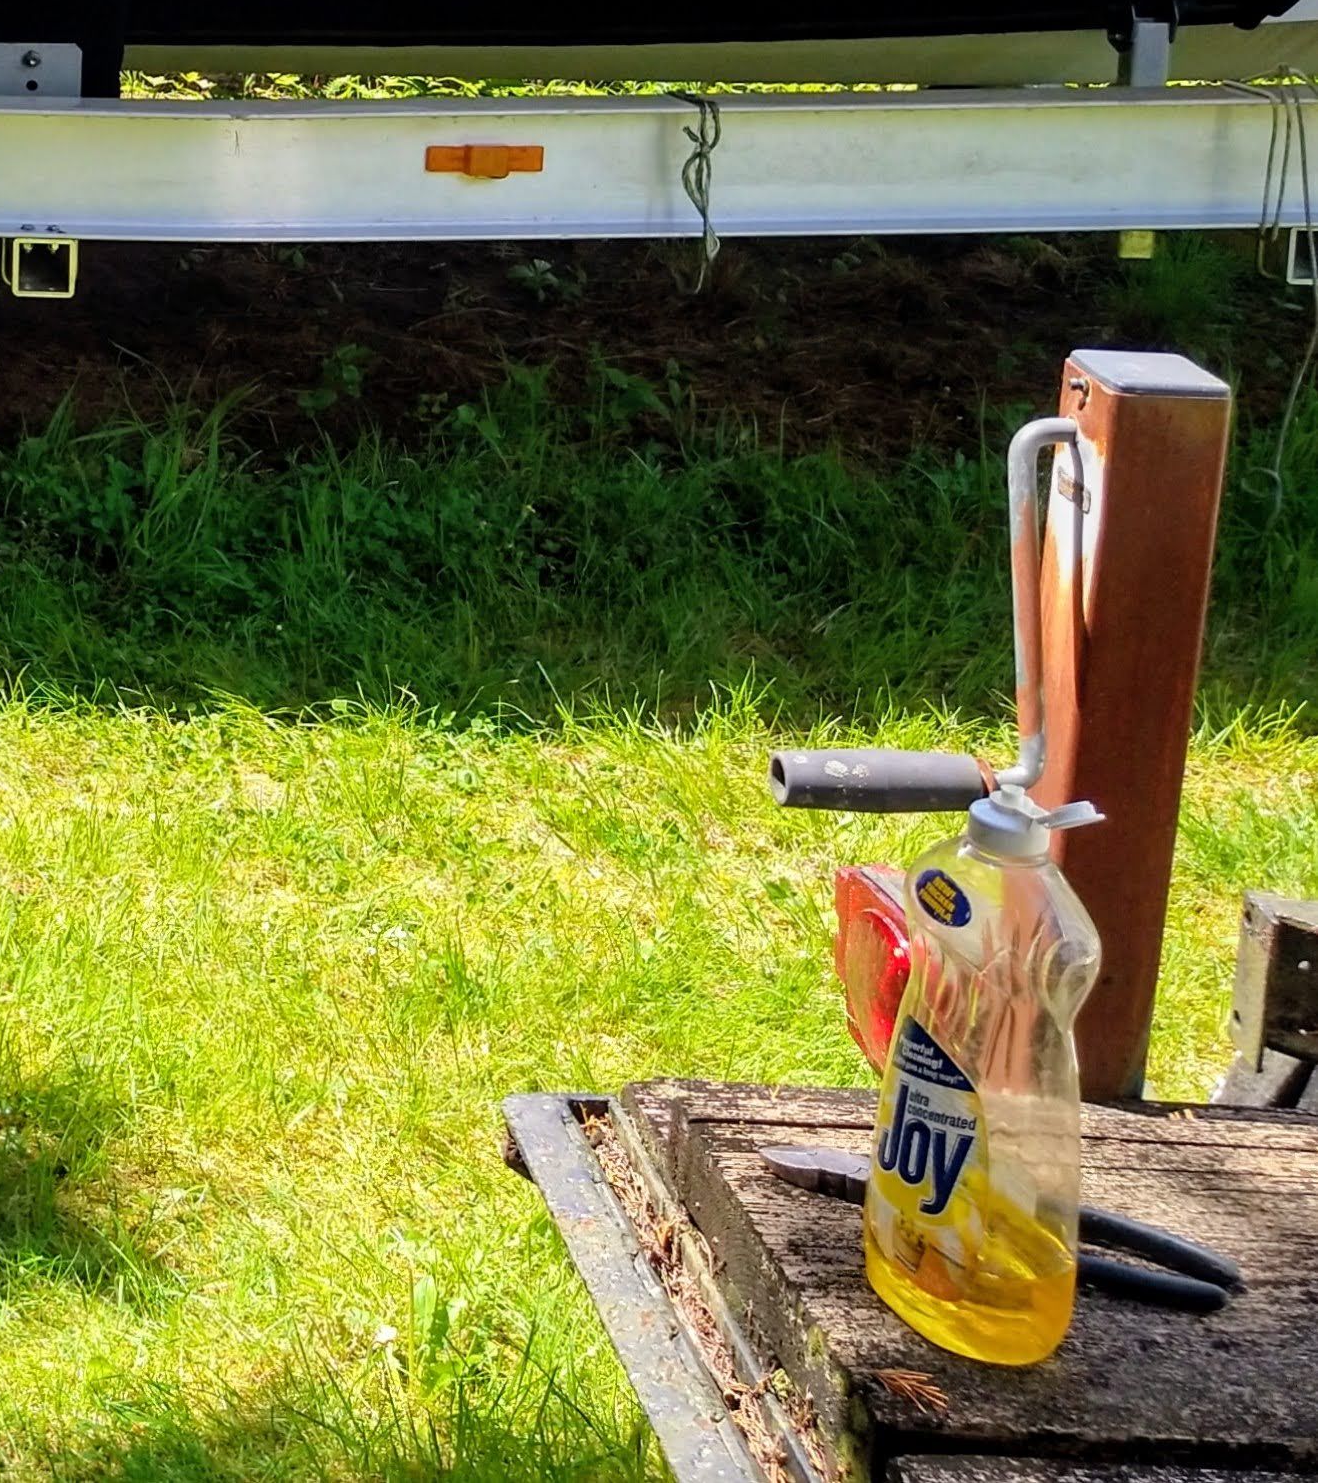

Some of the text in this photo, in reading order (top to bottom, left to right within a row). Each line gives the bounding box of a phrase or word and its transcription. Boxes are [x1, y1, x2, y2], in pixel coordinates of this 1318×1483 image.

[909, 1089, 930, 1107] ultra
[907, 1103, 978, 1131] concentrated
[877, 1079, 975, 1215] Joy
